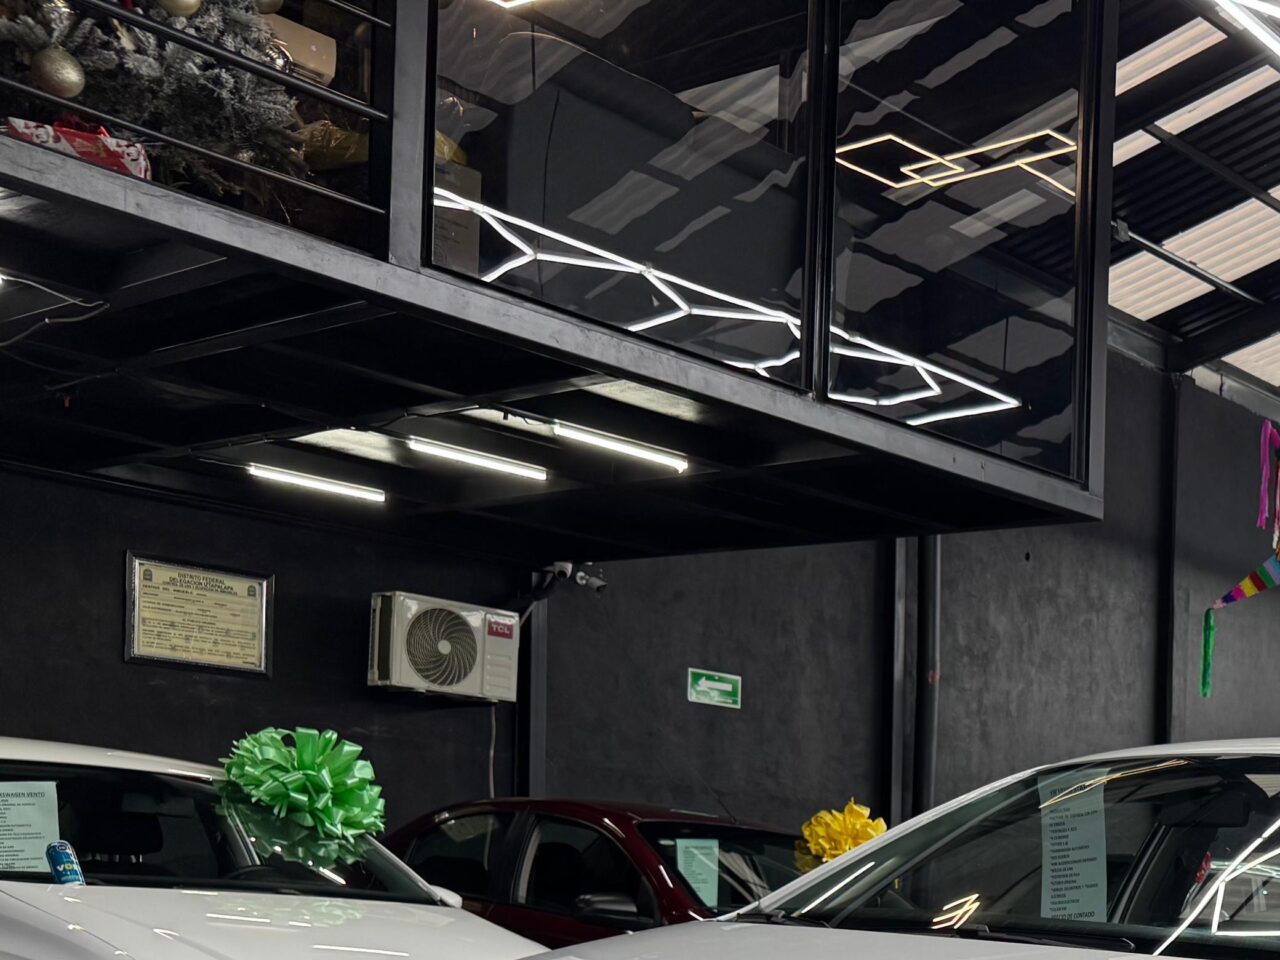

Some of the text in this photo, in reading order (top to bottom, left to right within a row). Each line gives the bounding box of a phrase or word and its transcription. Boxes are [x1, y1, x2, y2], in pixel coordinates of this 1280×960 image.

[178, 572, 225, 584] DISTRITO FEDERAL
[491, 624, 510, 634] TCL
